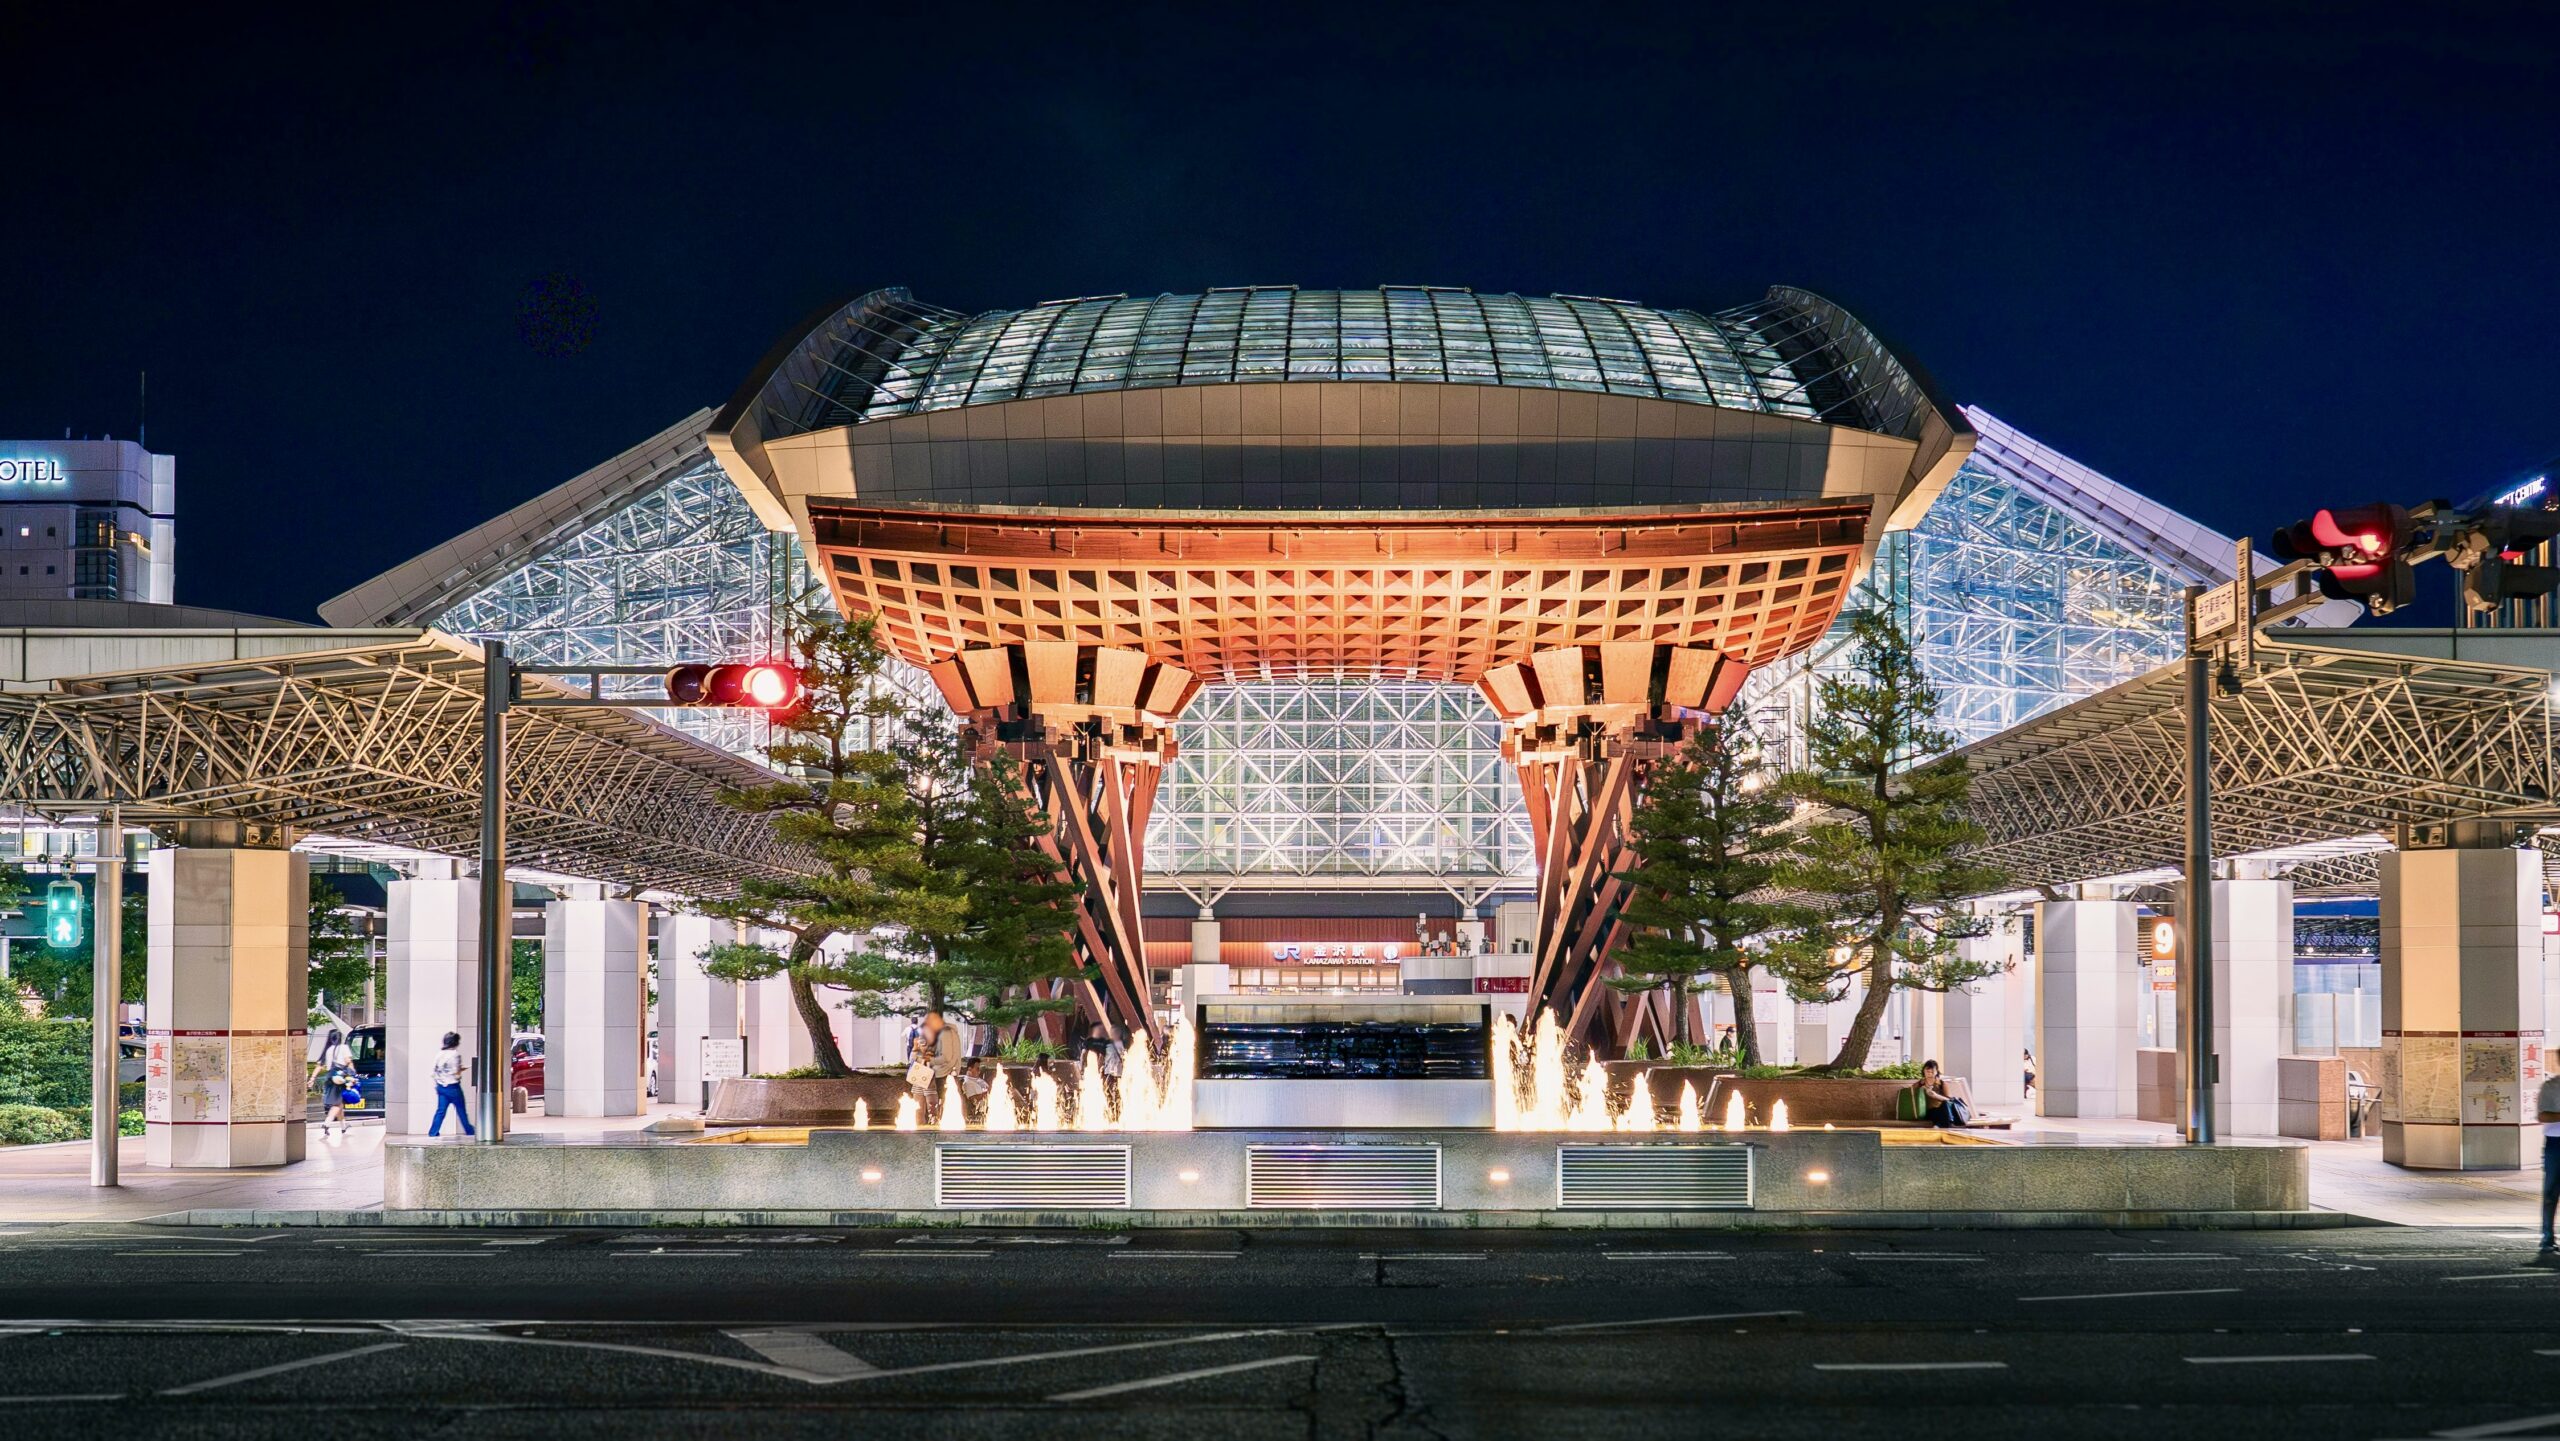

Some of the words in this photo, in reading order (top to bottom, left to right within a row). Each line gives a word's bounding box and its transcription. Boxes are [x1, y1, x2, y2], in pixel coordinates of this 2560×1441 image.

[2155, 922, 2174, 954] 9
[1273, 944, 1301, 960] JR
[1313, 944, 1365, 957] 金沢駅
[1303, 957, 1344, 965] KANAZAWA
[1346, 957, 1375, 965] STATION
